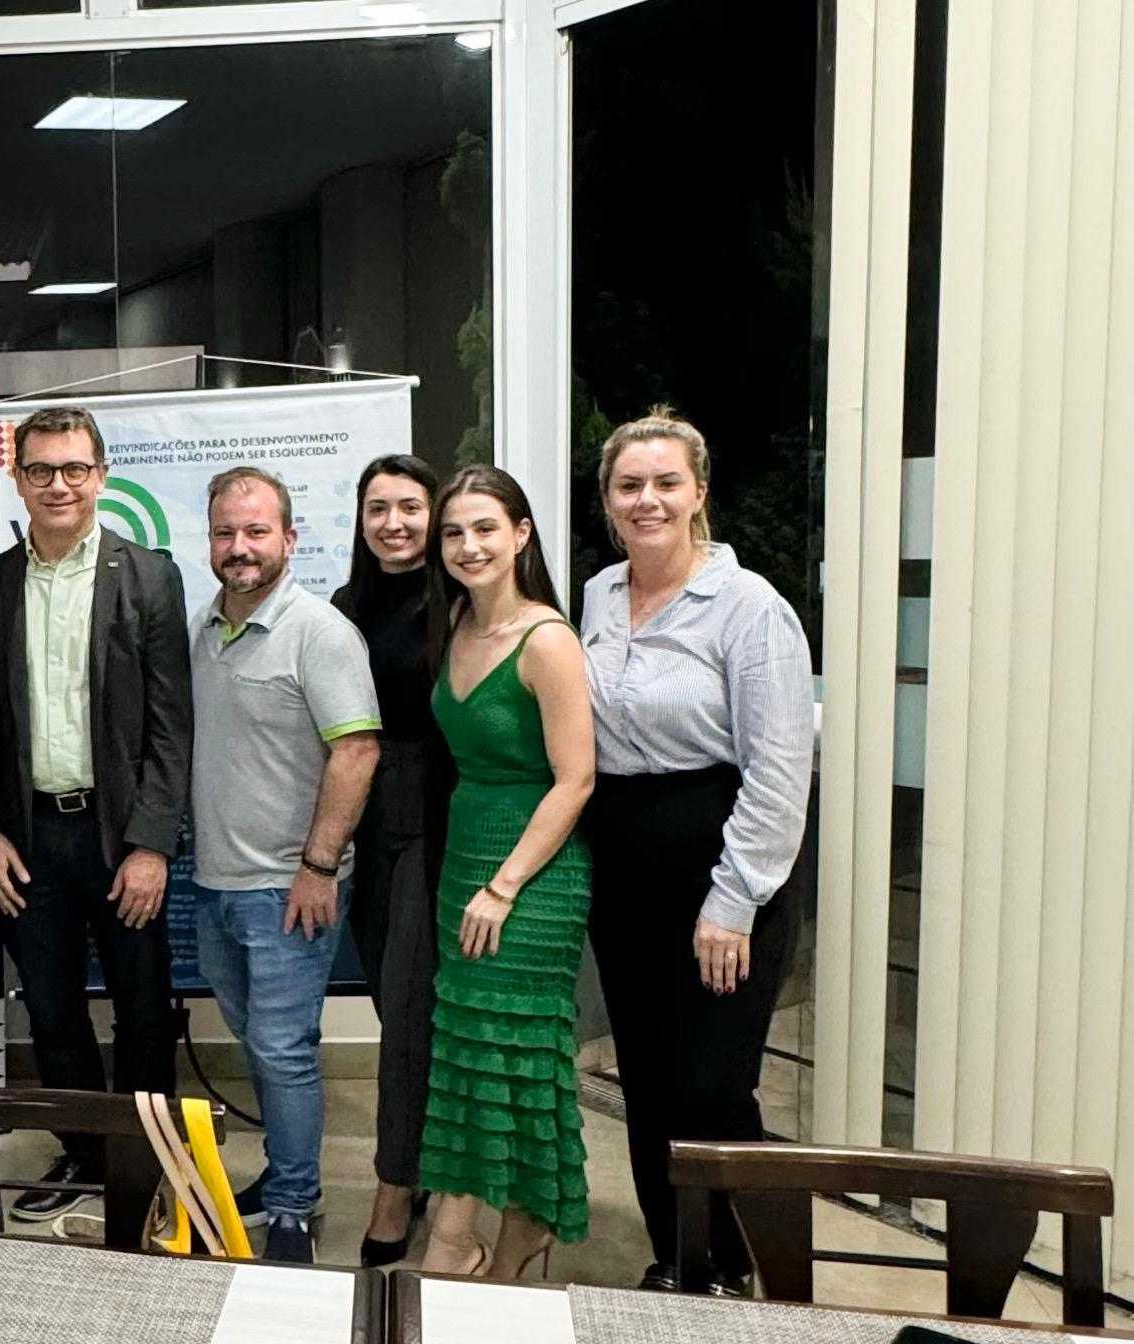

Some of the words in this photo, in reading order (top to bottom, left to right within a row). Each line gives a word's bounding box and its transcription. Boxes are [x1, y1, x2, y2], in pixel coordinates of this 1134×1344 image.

[109, 440, 197, 454] REIVINDICAÇÕES
[199, 440, 227, 449] PARA
[229, 438, 239, 448] O
[241, 432, 349, 447] DESENVOLVIMENTO
[110, 455, 174, 467] ATARINENSE
[177, 452, 202, 463] NÃO
[206, 450, 245, 461] PODEM
[247, 449, 266, 459] SER
[269, 446, 338, 458] ESQUECIDAS
